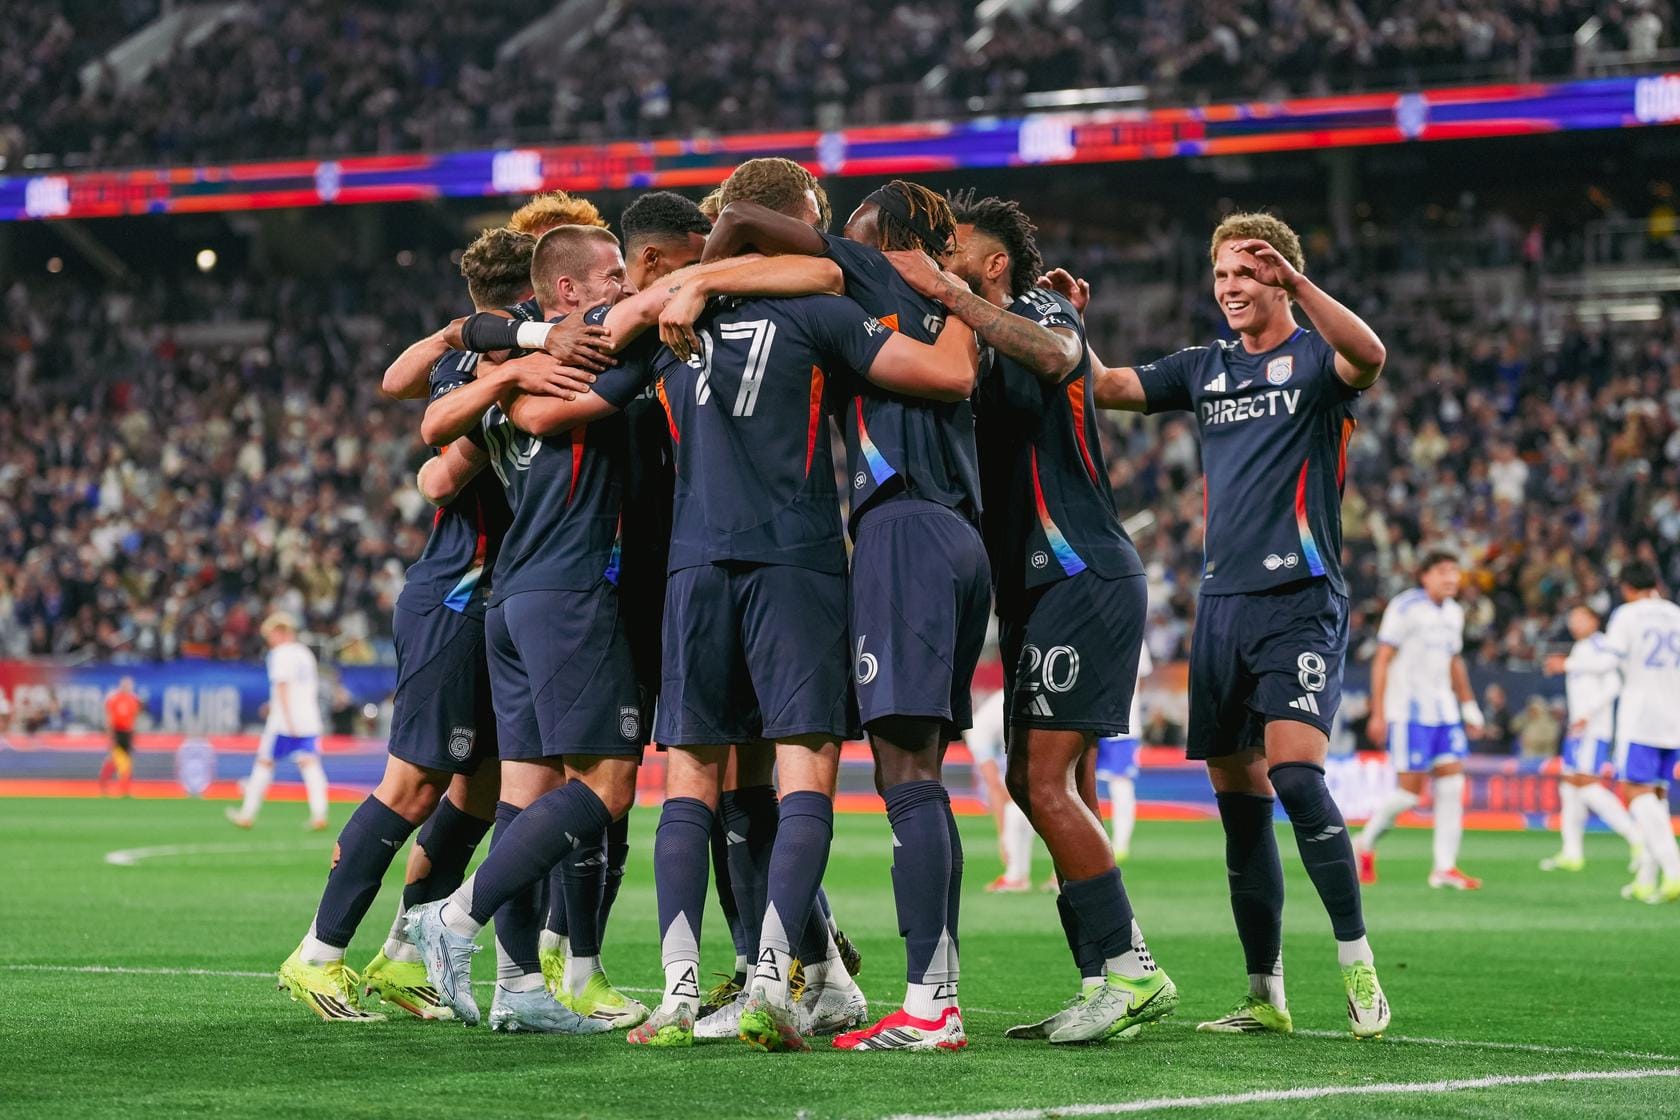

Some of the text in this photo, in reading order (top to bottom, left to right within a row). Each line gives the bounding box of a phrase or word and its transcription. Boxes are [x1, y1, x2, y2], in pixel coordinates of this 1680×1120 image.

[1200, 389, 1302, 425] DIRECTV
[855, 634, 878, 686] 6
[1016, 643, 1080, 694] 20
[1297, 651, 1326, 692] 8
